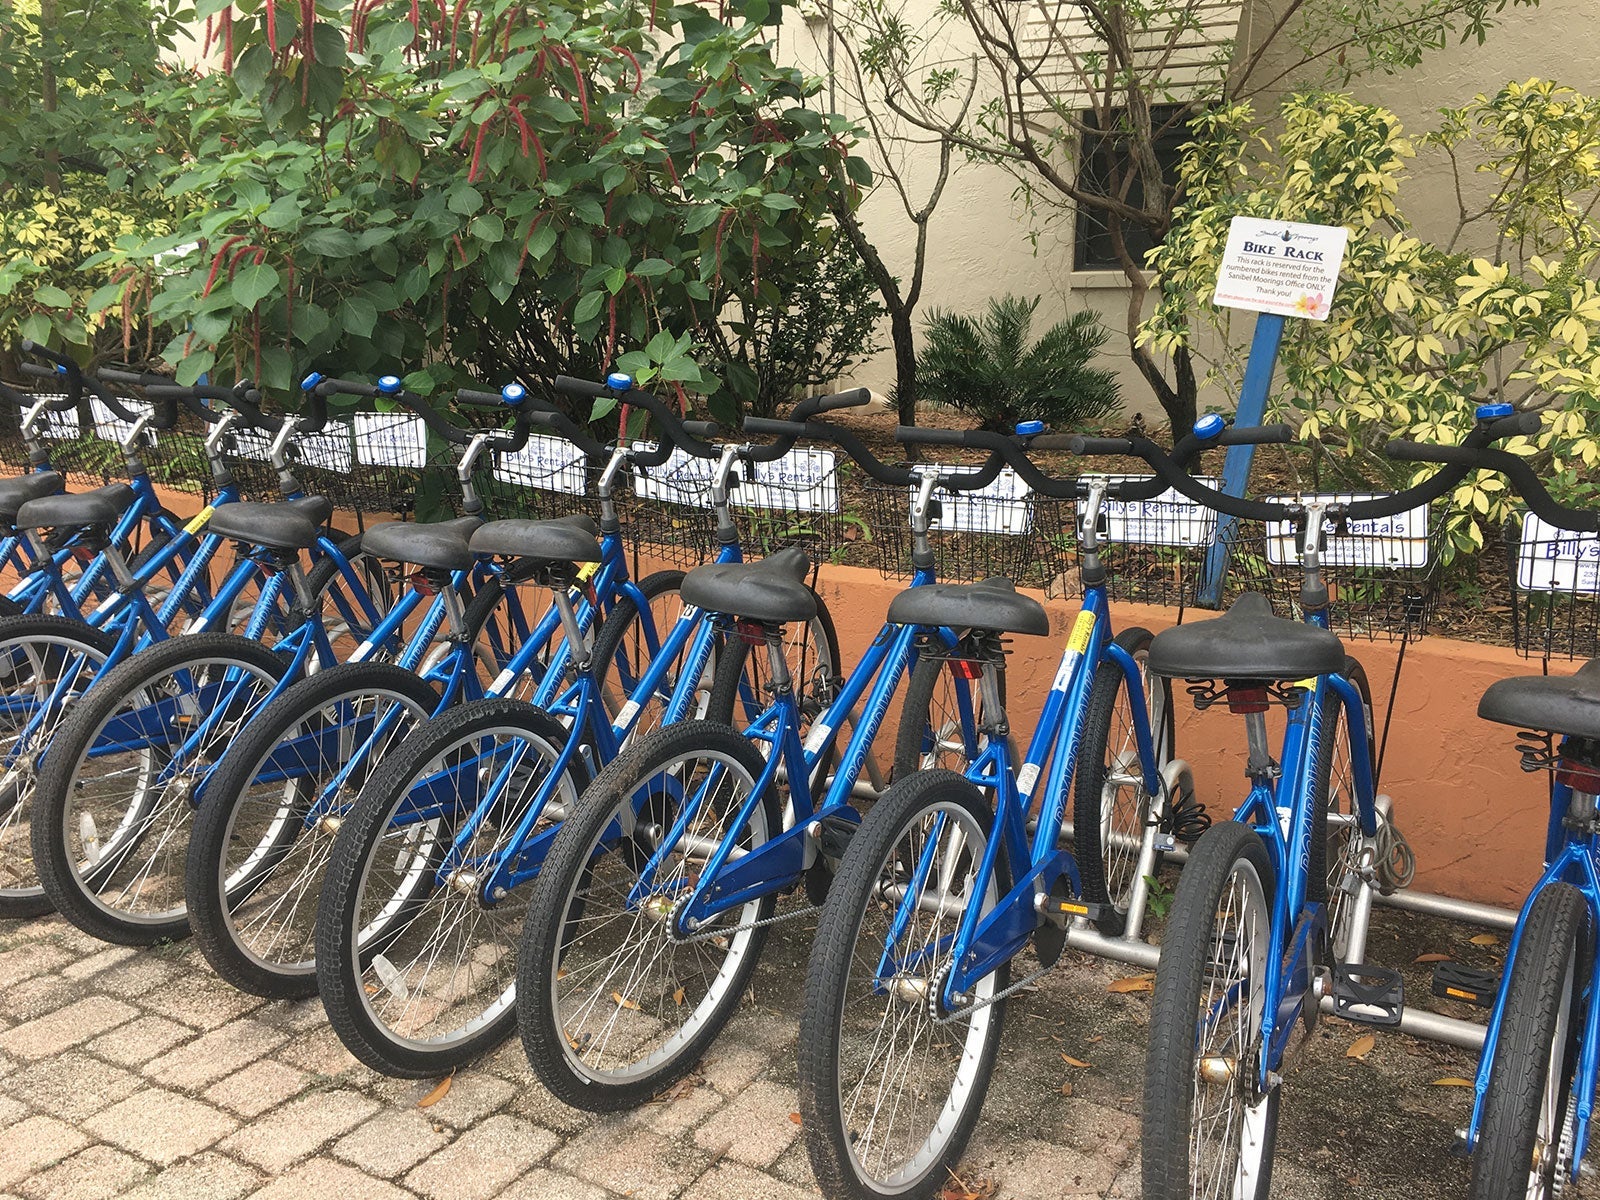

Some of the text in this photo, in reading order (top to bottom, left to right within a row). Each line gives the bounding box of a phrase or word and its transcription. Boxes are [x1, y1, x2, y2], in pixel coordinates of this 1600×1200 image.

[1238, 256, 1249, 264] This
[1251, 258, 1264, 266] rack
[1273, 262, 1300, 271] reserved
[1302, 264, 1312, 273] for
[1314, 266, 1324, 274] the
[1226, 265, 1332, 283] numbered bikes rented from the
[1228, 272, 1252, 281] Sanibel
[1253, 275, 1284, 287] Moorings
[1285, 279, 1305, 289] Office
[1256, 286, 1292, 298] Thank you!
[1141, 502, 1198, 517] Rentals
[1546, 540, 1600, 560] Billy's
